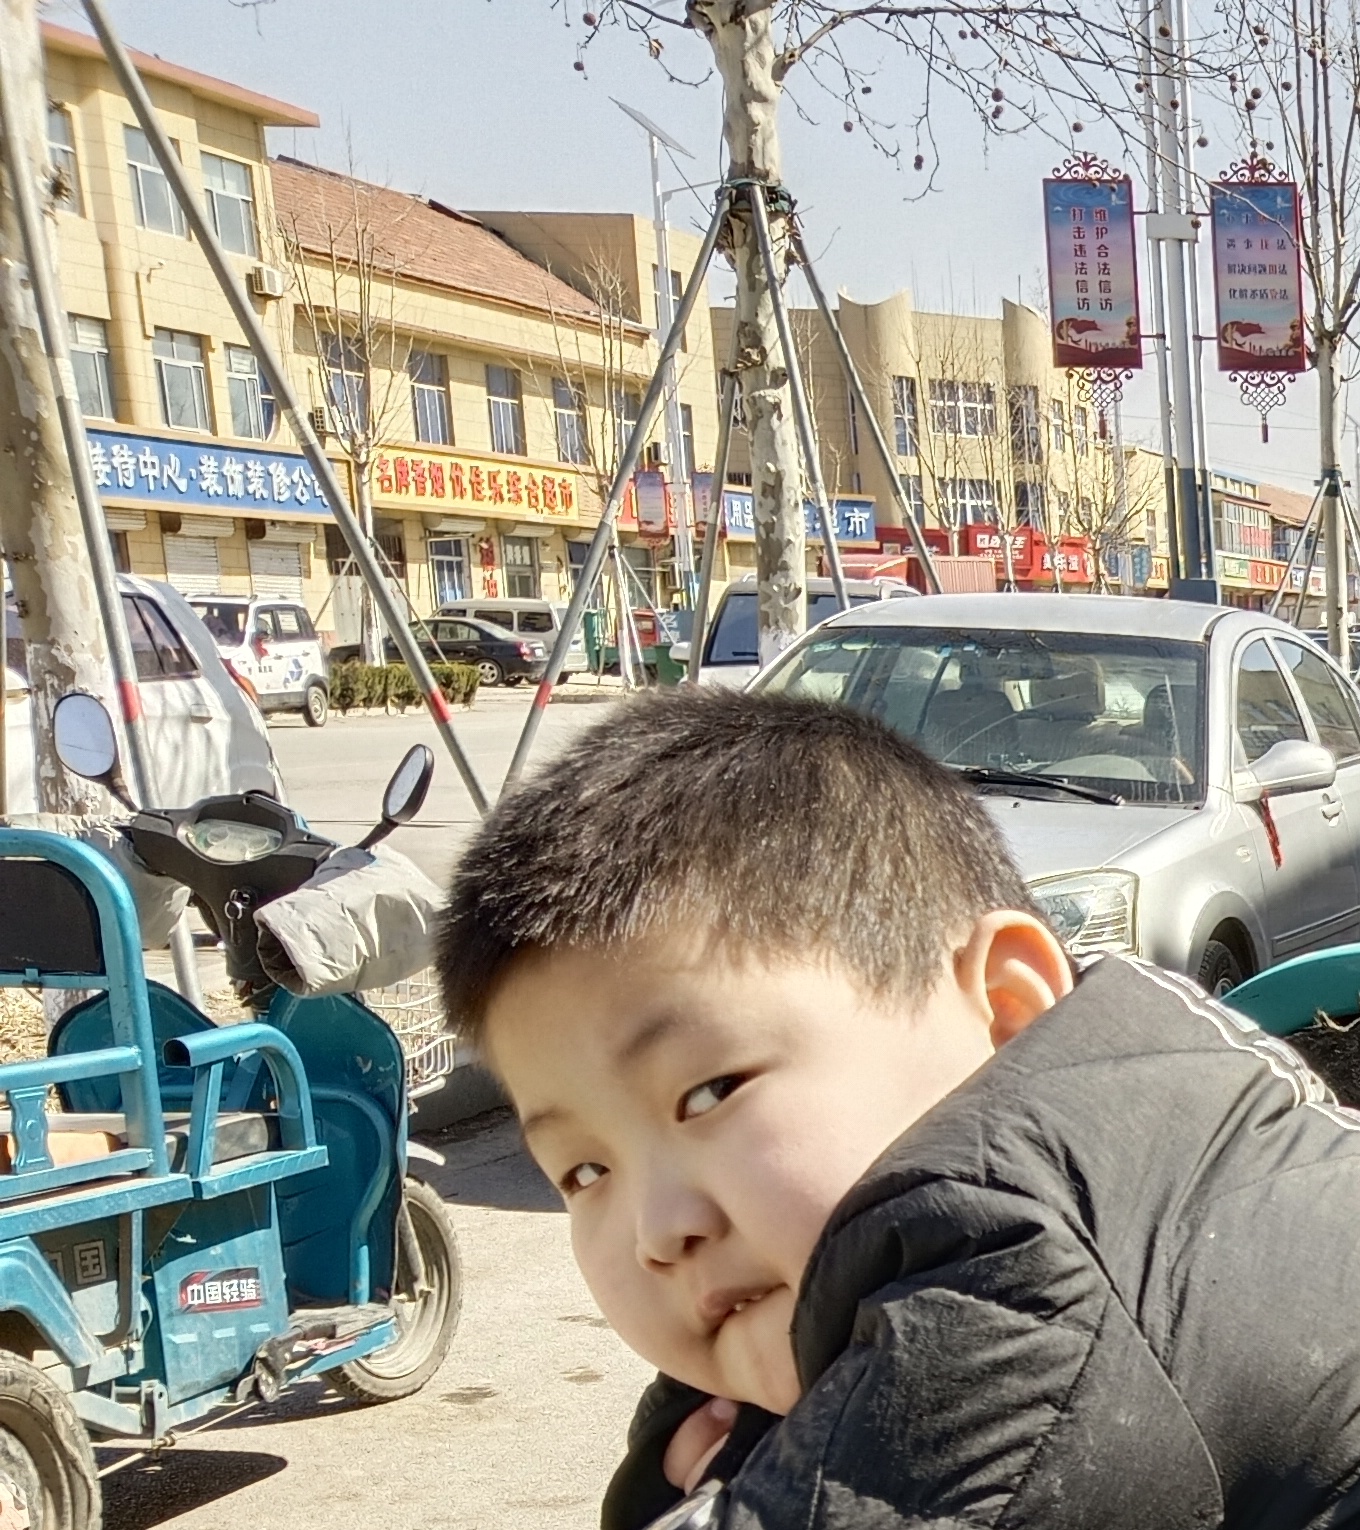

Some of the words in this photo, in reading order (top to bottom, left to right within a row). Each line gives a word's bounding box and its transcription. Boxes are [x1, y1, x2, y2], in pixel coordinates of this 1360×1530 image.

[1070, 207, 1090, 312] 打击违法信访
[1093, 207, 1113, 312] 维护合法信访
[187, 1278, 260, 1306] 中国轻骑
